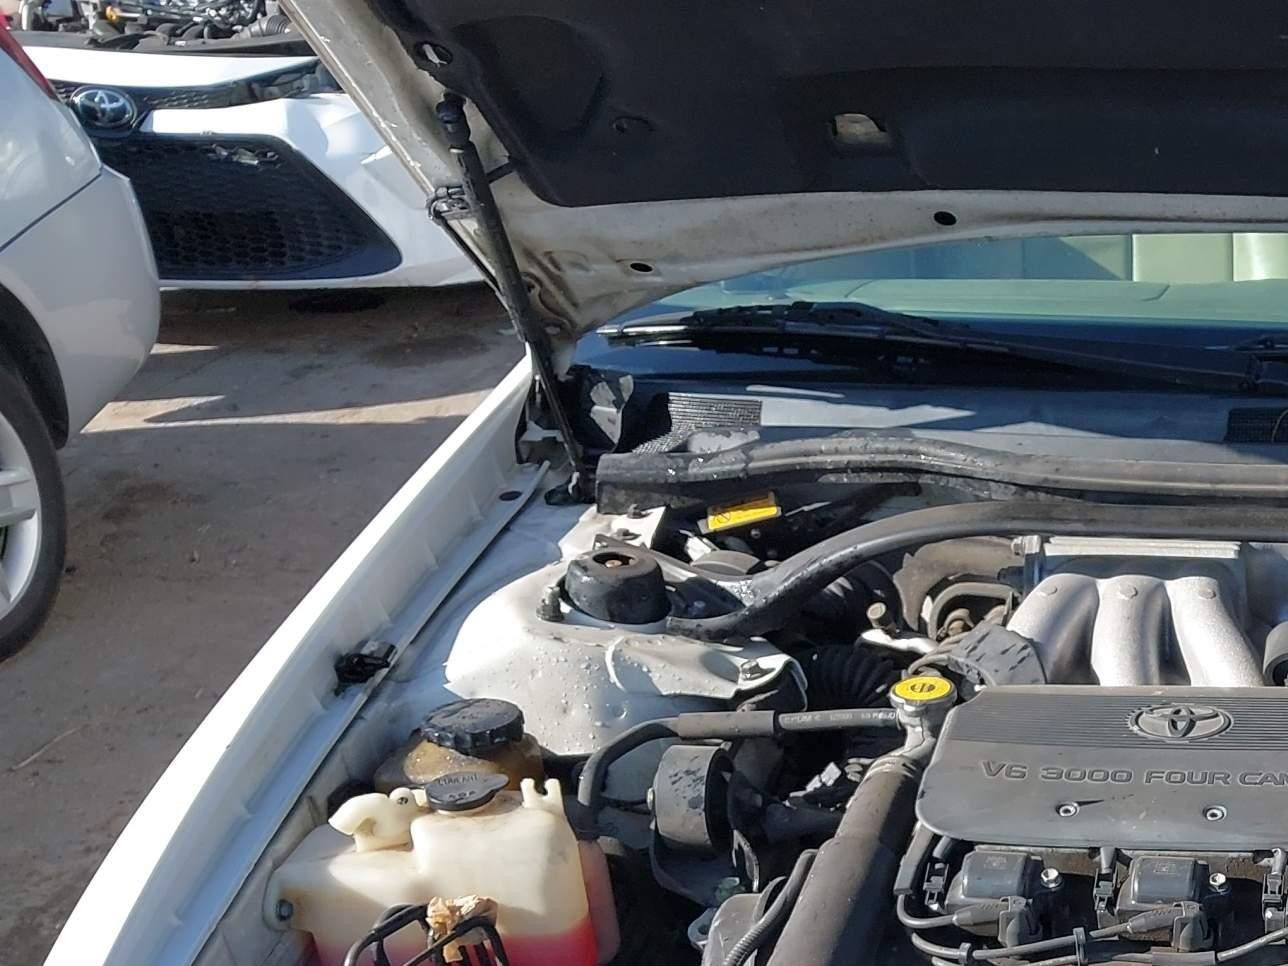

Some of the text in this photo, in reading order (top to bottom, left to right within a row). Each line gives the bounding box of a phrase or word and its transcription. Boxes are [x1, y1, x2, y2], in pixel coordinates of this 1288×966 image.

[981, 760, 1027, 780] V6
[1040, 766, 1133, 784] 3000
[1144, 770, 1231, 786] FOUR
